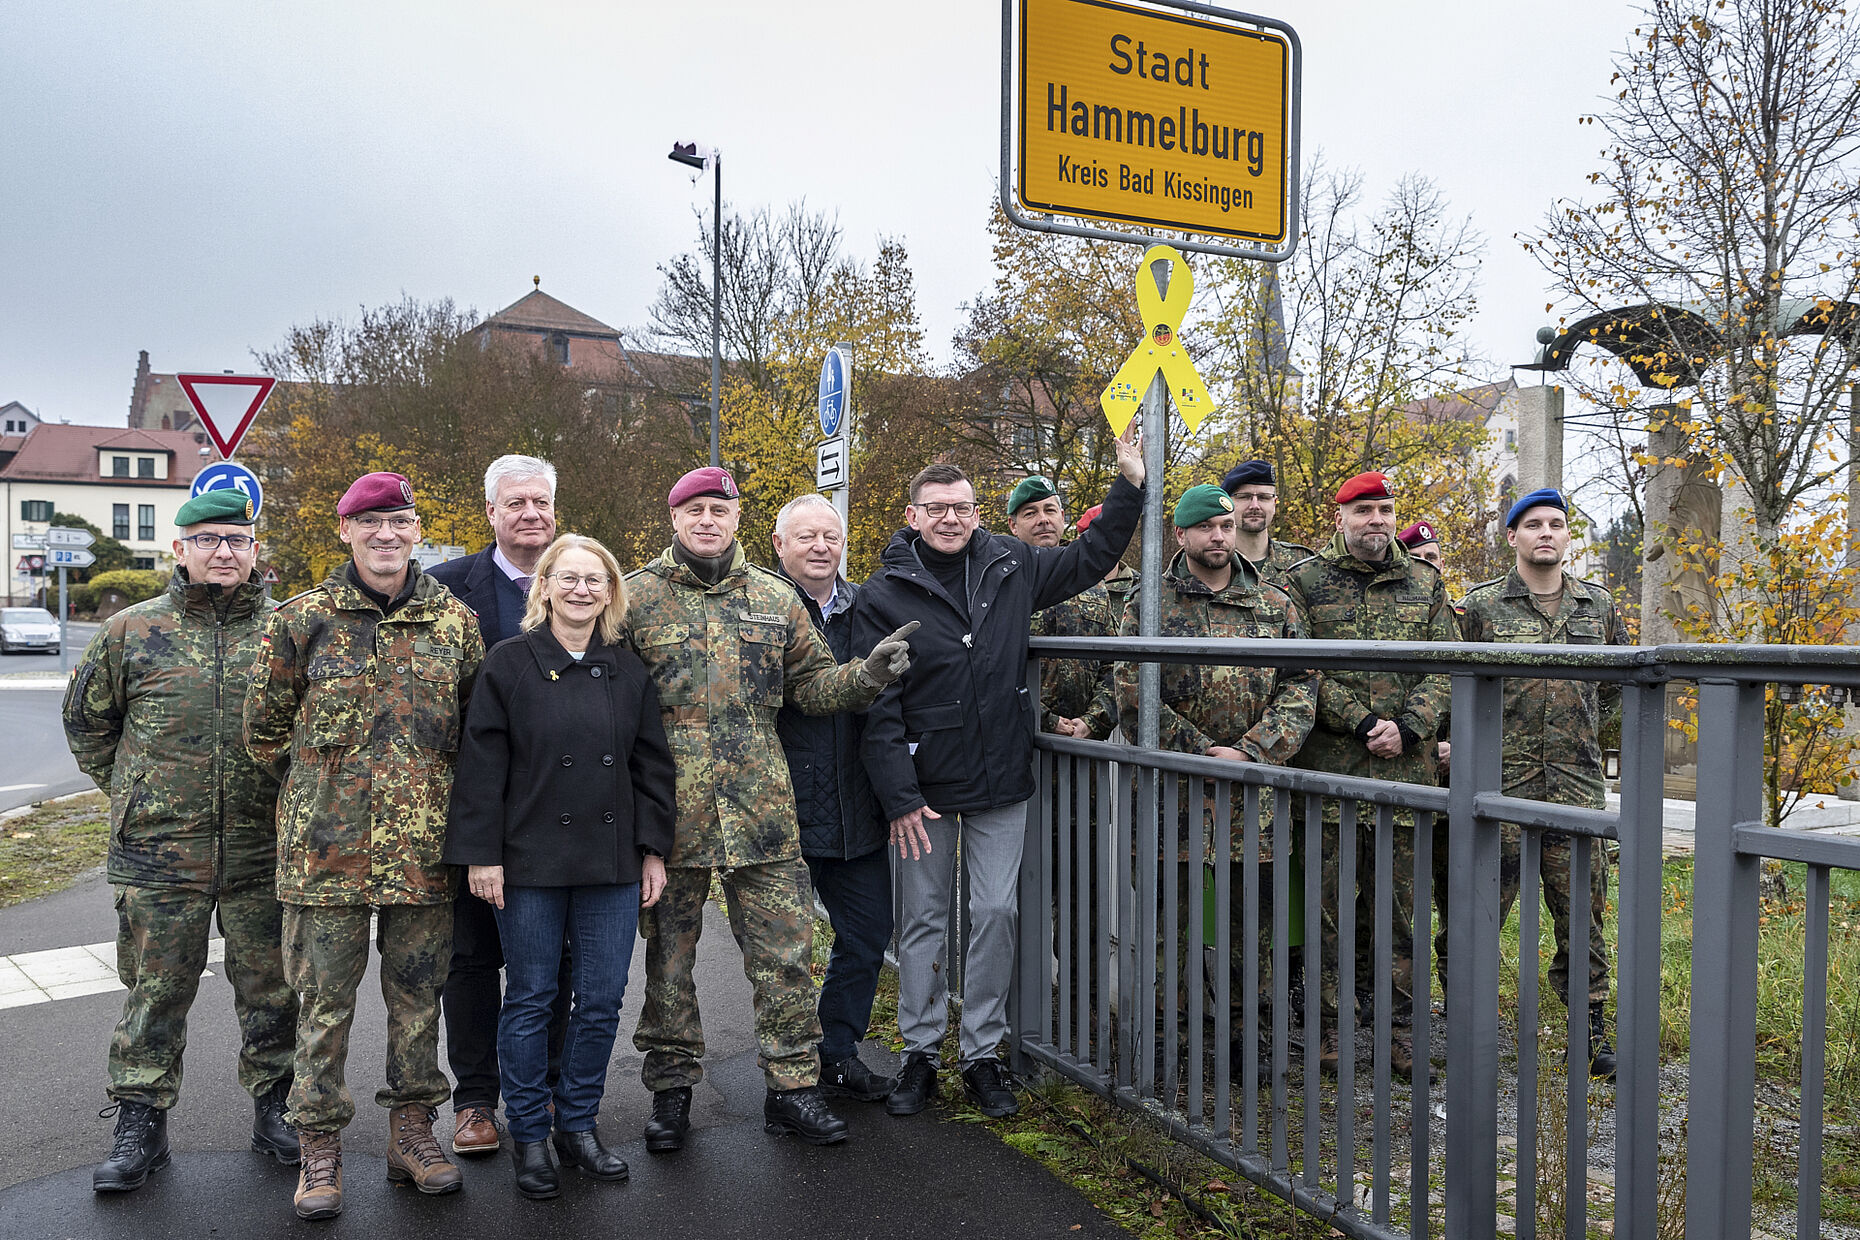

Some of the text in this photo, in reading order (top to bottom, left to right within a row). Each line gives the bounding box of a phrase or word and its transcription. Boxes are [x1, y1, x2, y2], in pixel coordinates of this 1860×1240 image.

[1108, 34, 1210, 90] Stadt
[1047, 82, 1264, 177] Hammelburg
[1058, 154, 1254, 213] Kreis Bad Kissingen
